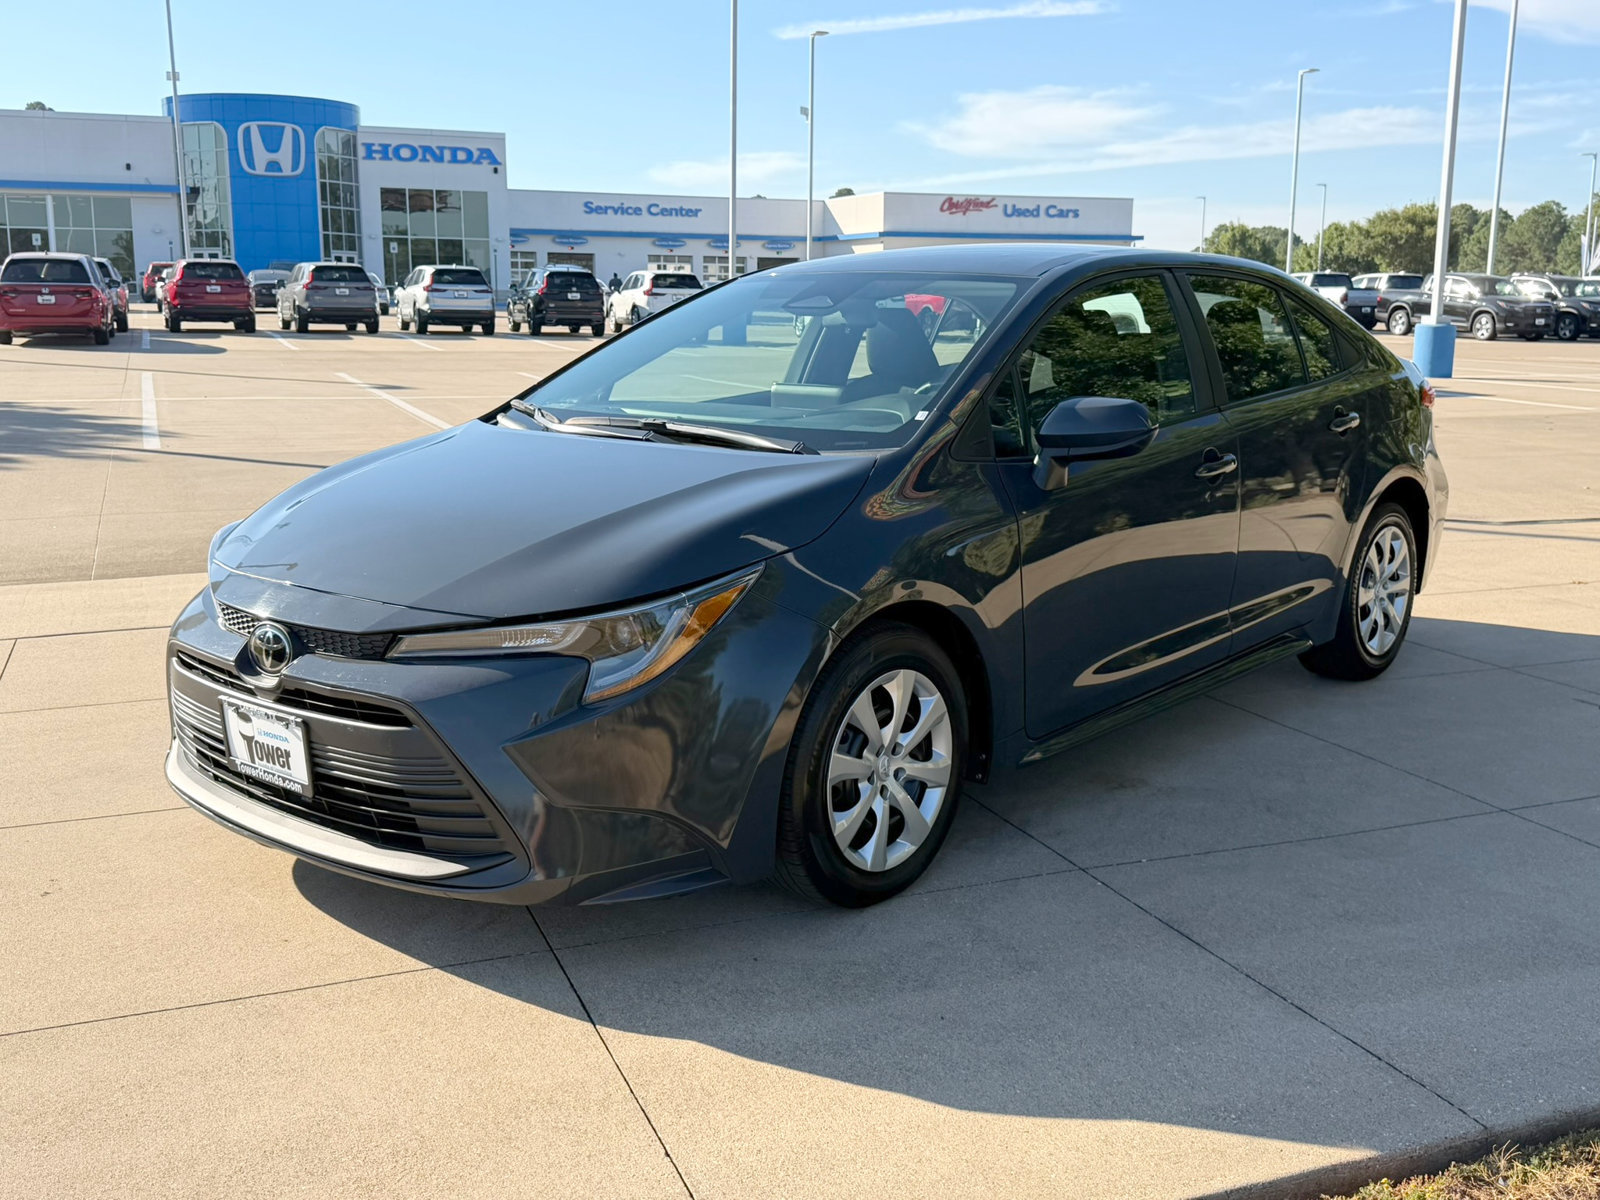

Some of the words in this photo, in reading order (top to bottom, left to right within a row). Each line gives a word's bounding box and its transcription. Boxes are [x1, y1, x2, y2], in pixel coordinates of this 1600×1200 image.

[361, 142, 502, 165] HONDA
[583, 201, 643, 217] Service
[647, 203, 702, 218] Center
[1003, 203, 1041, 218] Used
[1045, 204, 1080, 218] Cars
[263, 732, 290, 744] HONDA
[239, 731, 292, 771] Tower
[236, 759, 303, 794] TowerHonda.com
